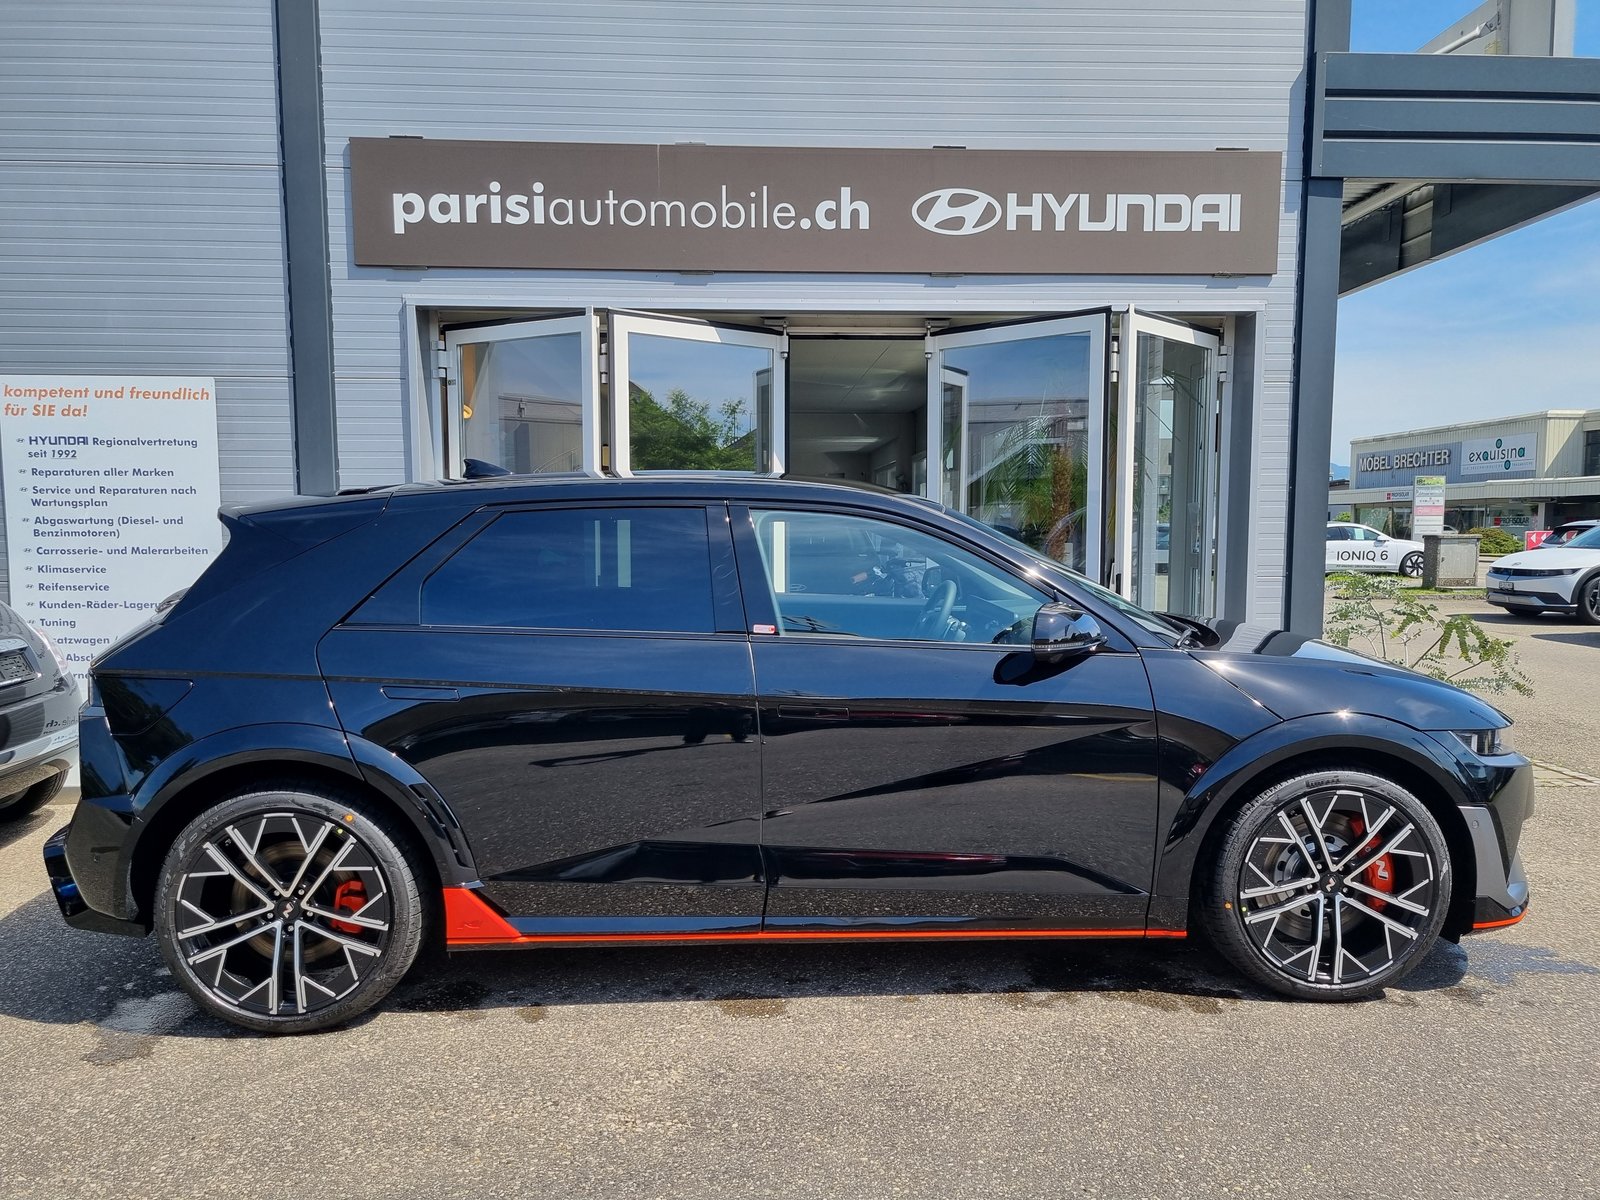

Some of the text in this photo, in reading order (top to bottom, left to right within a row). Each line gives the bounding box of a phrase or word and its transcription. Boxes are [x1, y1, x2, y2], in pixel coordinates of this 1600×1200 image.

[392, 181, 870, 234] parisiautomobile.ch
[1006, 193, 1241, 232] HYUNDAI
[3, 385, 210, 401] kompetent und freundlich
[4, 404, 88, 417] für SIE da!
[29, 436, 198, 448] HYUNDAI Regionalvertretung
[28, 450, 77, 459] seit 1992
[1394, 449, 1451, 469] BRECHTER
[31, 468, 174, 479] Reparaturen aller Marken
[32, 486, 197, 497] Service und Reparaturen nach
[31, 498, 108, 509] Wartungsplan
[34, 516, 183, 527] Abgaswartung (Diesel- und
[33, 529, 120, 539] Benzinmotoren)
[36, 546, 209, 555] Carrosserie- und Malerarbeiten
[1337, 551, 1388, 562] IONIQ 6
[37, 565, 107, 574] Klimaservice
[38, 583, 110, 592] Reifenservice
[40, 619, 76, 629] Tuning
